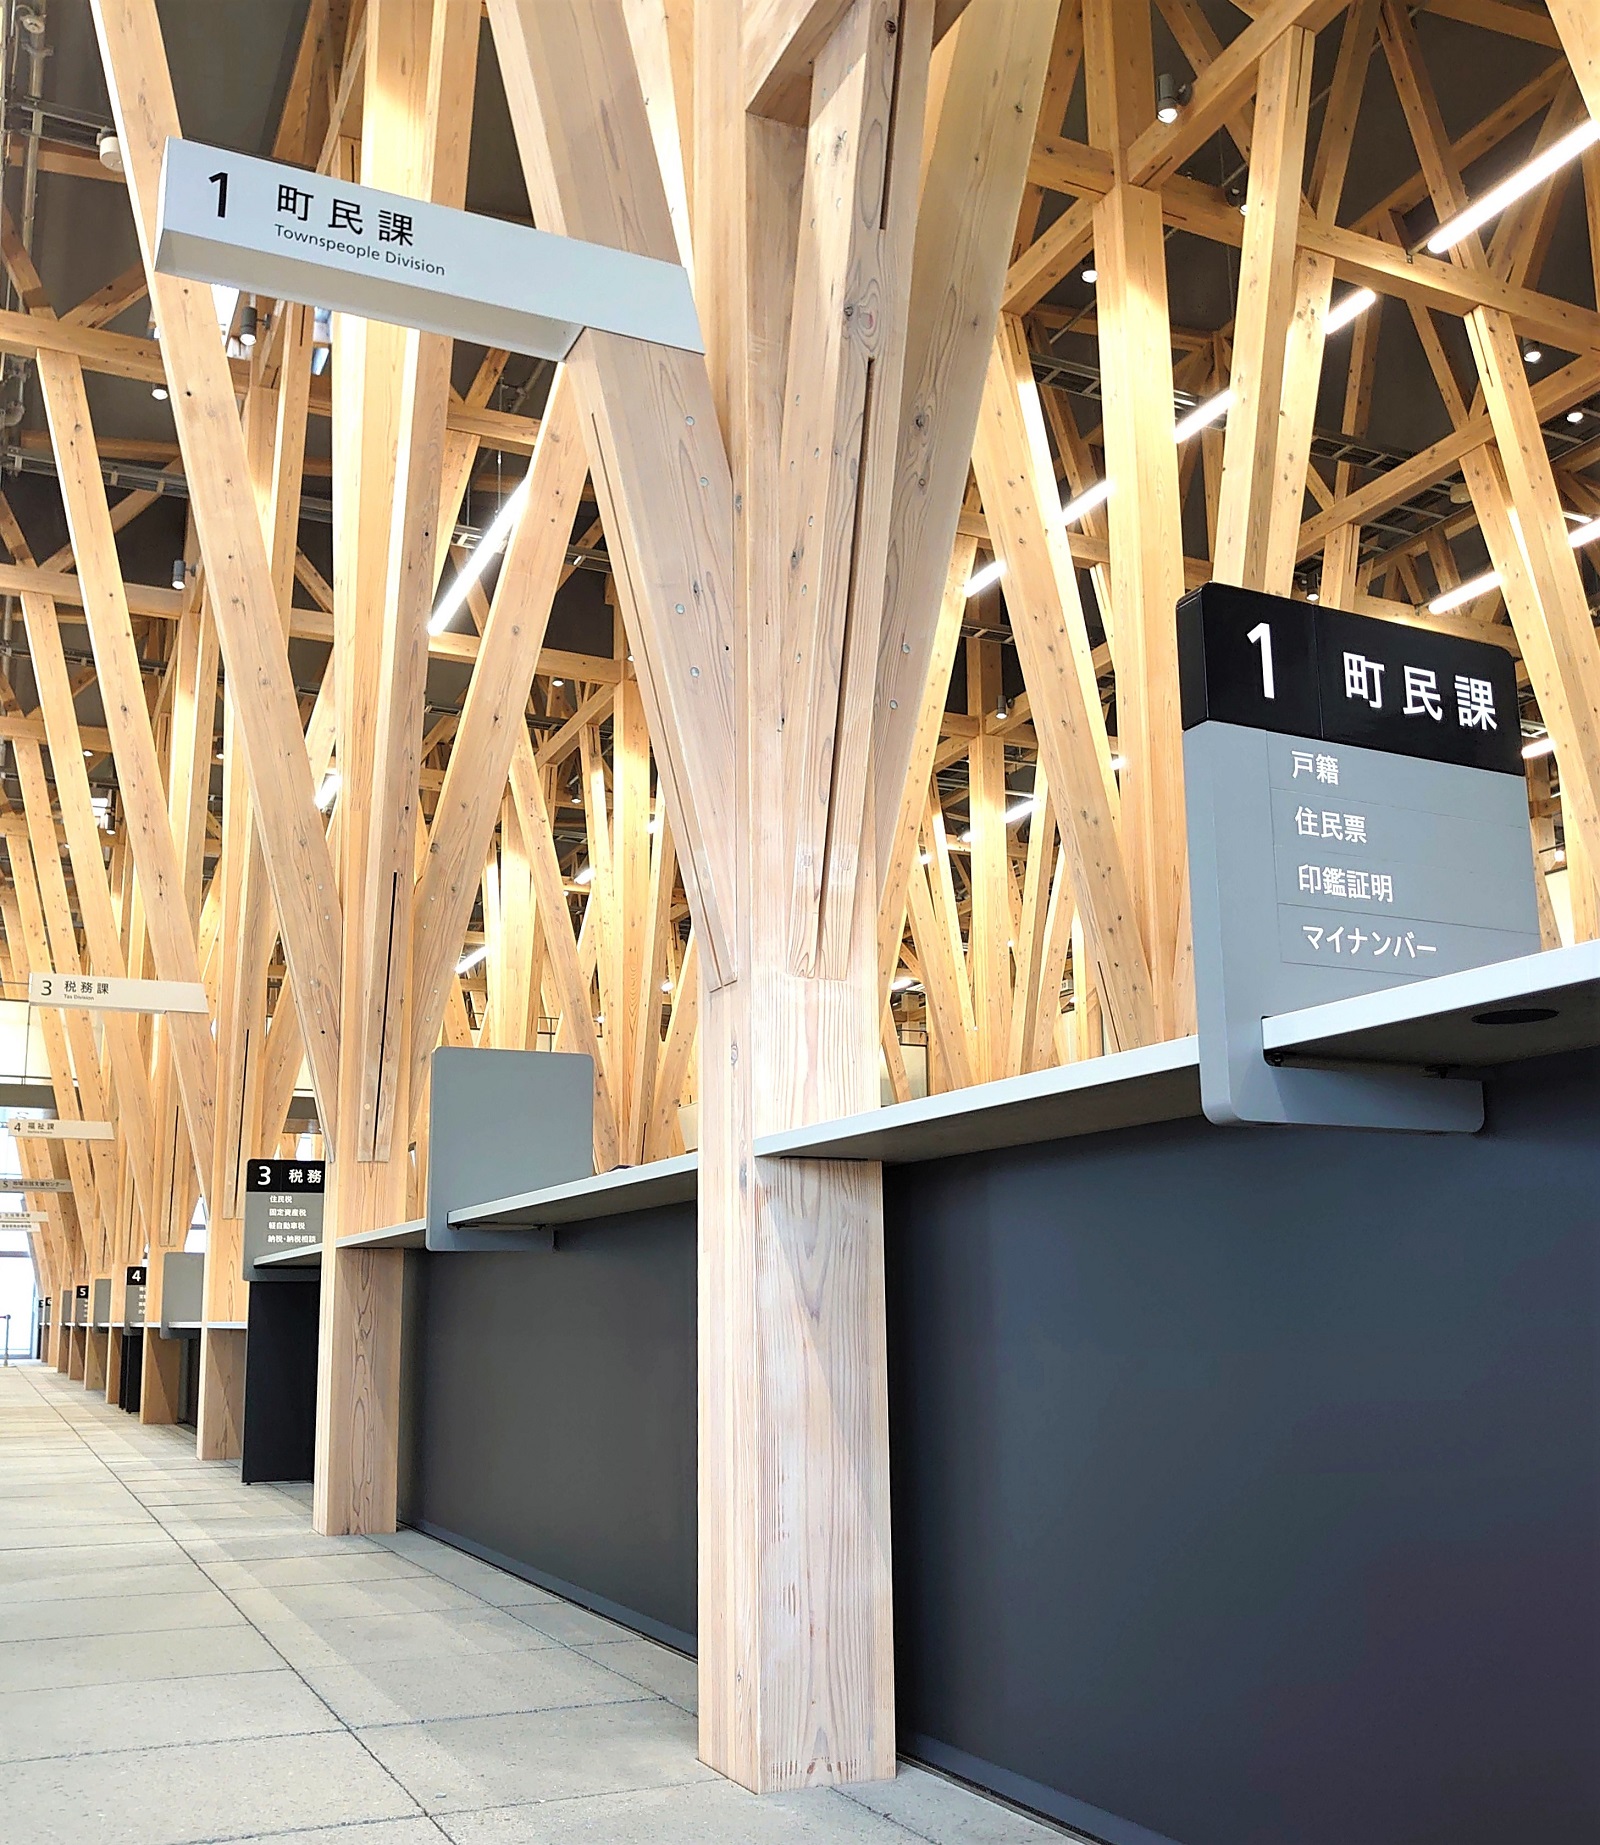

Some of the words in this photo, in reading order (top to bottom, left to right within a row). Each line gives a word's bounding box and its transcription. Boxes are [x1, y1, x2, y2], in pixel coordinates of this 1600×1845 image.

[208, 171, 229, 218] 1
[276, 183, 415, 247] 町民課
[274, 223, 380, 262] Townspeople
[384, 250, 446, 276] Division
[1246, 622, 1275, 699] 1
[1343, 651, 1498, 731] 町民課
[1291, 749, 1339, 786] 戸籍
[1294, 806, 1368, 844] 住民票
[1298, 864, 1394, 903] 印鑑証明
[1302, 925, 1437, 959] マイナンバー
[41, 980, 52, 996] 3
[64, 980, 110, 995] 税務課
[14, 1122, 21, 1132] 4
[257, 1165, 271, 1186] 3
[288, 1168, 322, 1184] 税務
[269, 1195, 293, 1203] 住民税
[269, 1208, 307, 1217] 固定資産税
[268, 1222, 306, 1230] 軽自動車税
[131, 1270, 141, 1282] 4
[80, 1287, 87, 1297] 5
